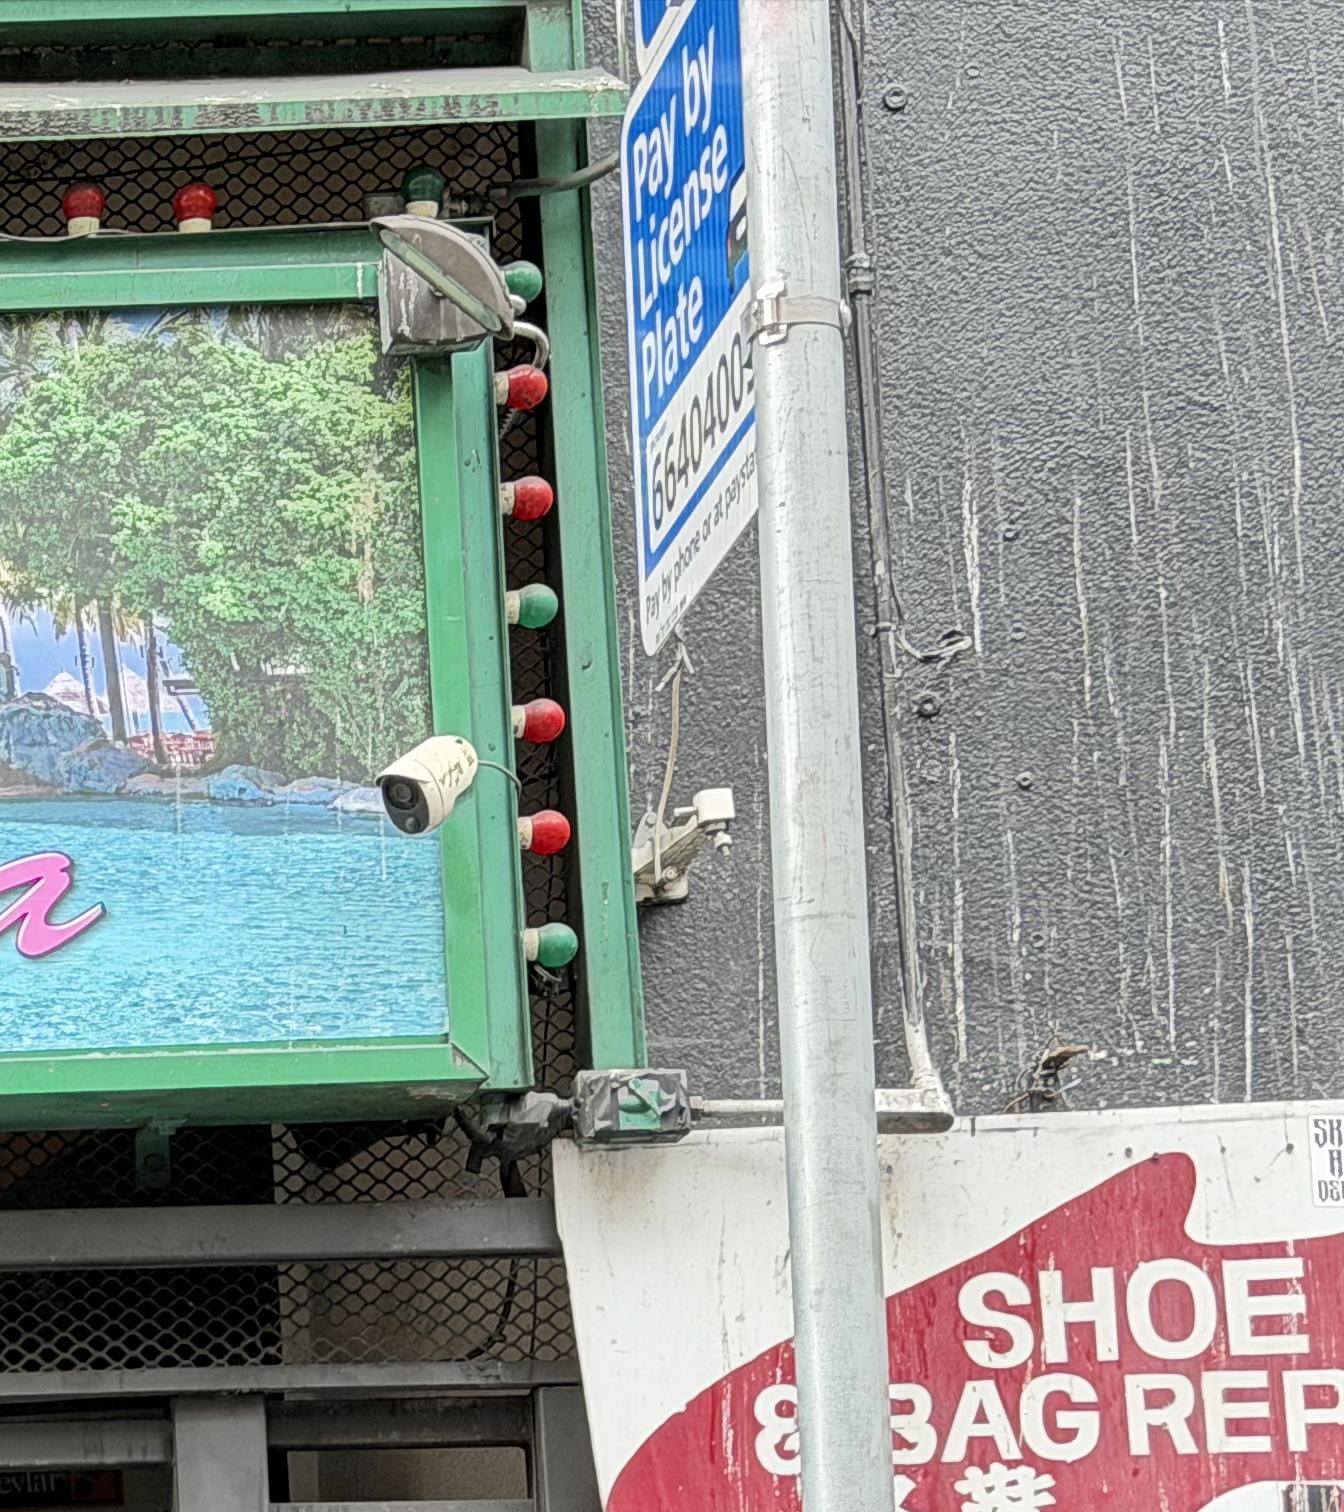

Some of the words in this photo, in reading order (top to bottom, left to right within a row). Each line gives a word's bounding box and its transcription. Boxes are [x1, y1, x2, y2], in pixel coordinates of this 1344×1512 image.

[633, 93, 676, 223] Pay
[682, 24, 714, 137] by
[638, 124, 728, 320] License
[641, 275, 703, 420] Plate
[725, 450, 755, 511] paysta
[958, 1257, 1310, 1369] SHOE
[888, 1373, 1100, 1464] BAG
